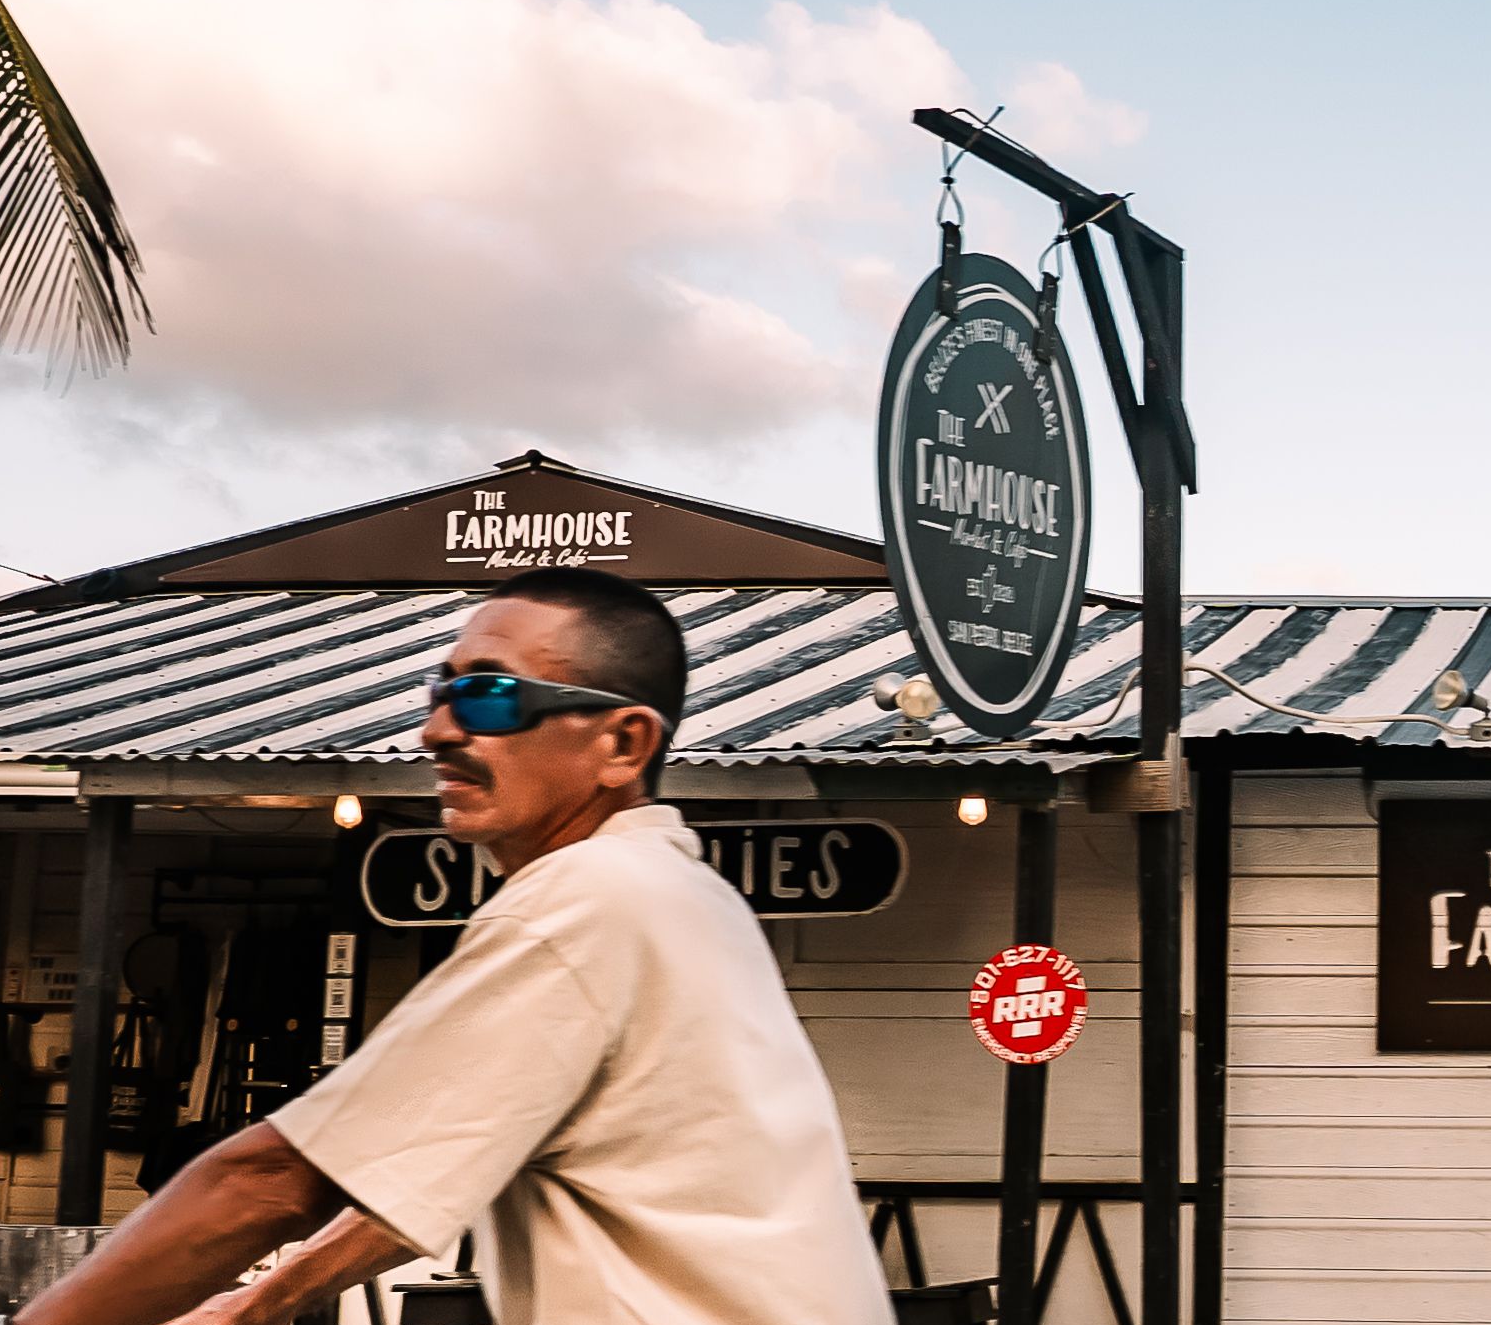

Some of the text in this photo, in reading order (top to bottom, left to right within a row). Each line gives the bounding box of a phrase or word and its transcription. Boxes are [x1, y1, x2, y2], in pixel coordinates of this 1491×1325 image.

[936, 409, 966, 448] THE
[473, 490, 507, 511] THE
[915, 437, 1060, 537] FARMHOUSE
[445, 510, 633, 550] FARMHOUSE
[536, 550, 554, 567] &
[992, 990, 1066, 1024] RRR
